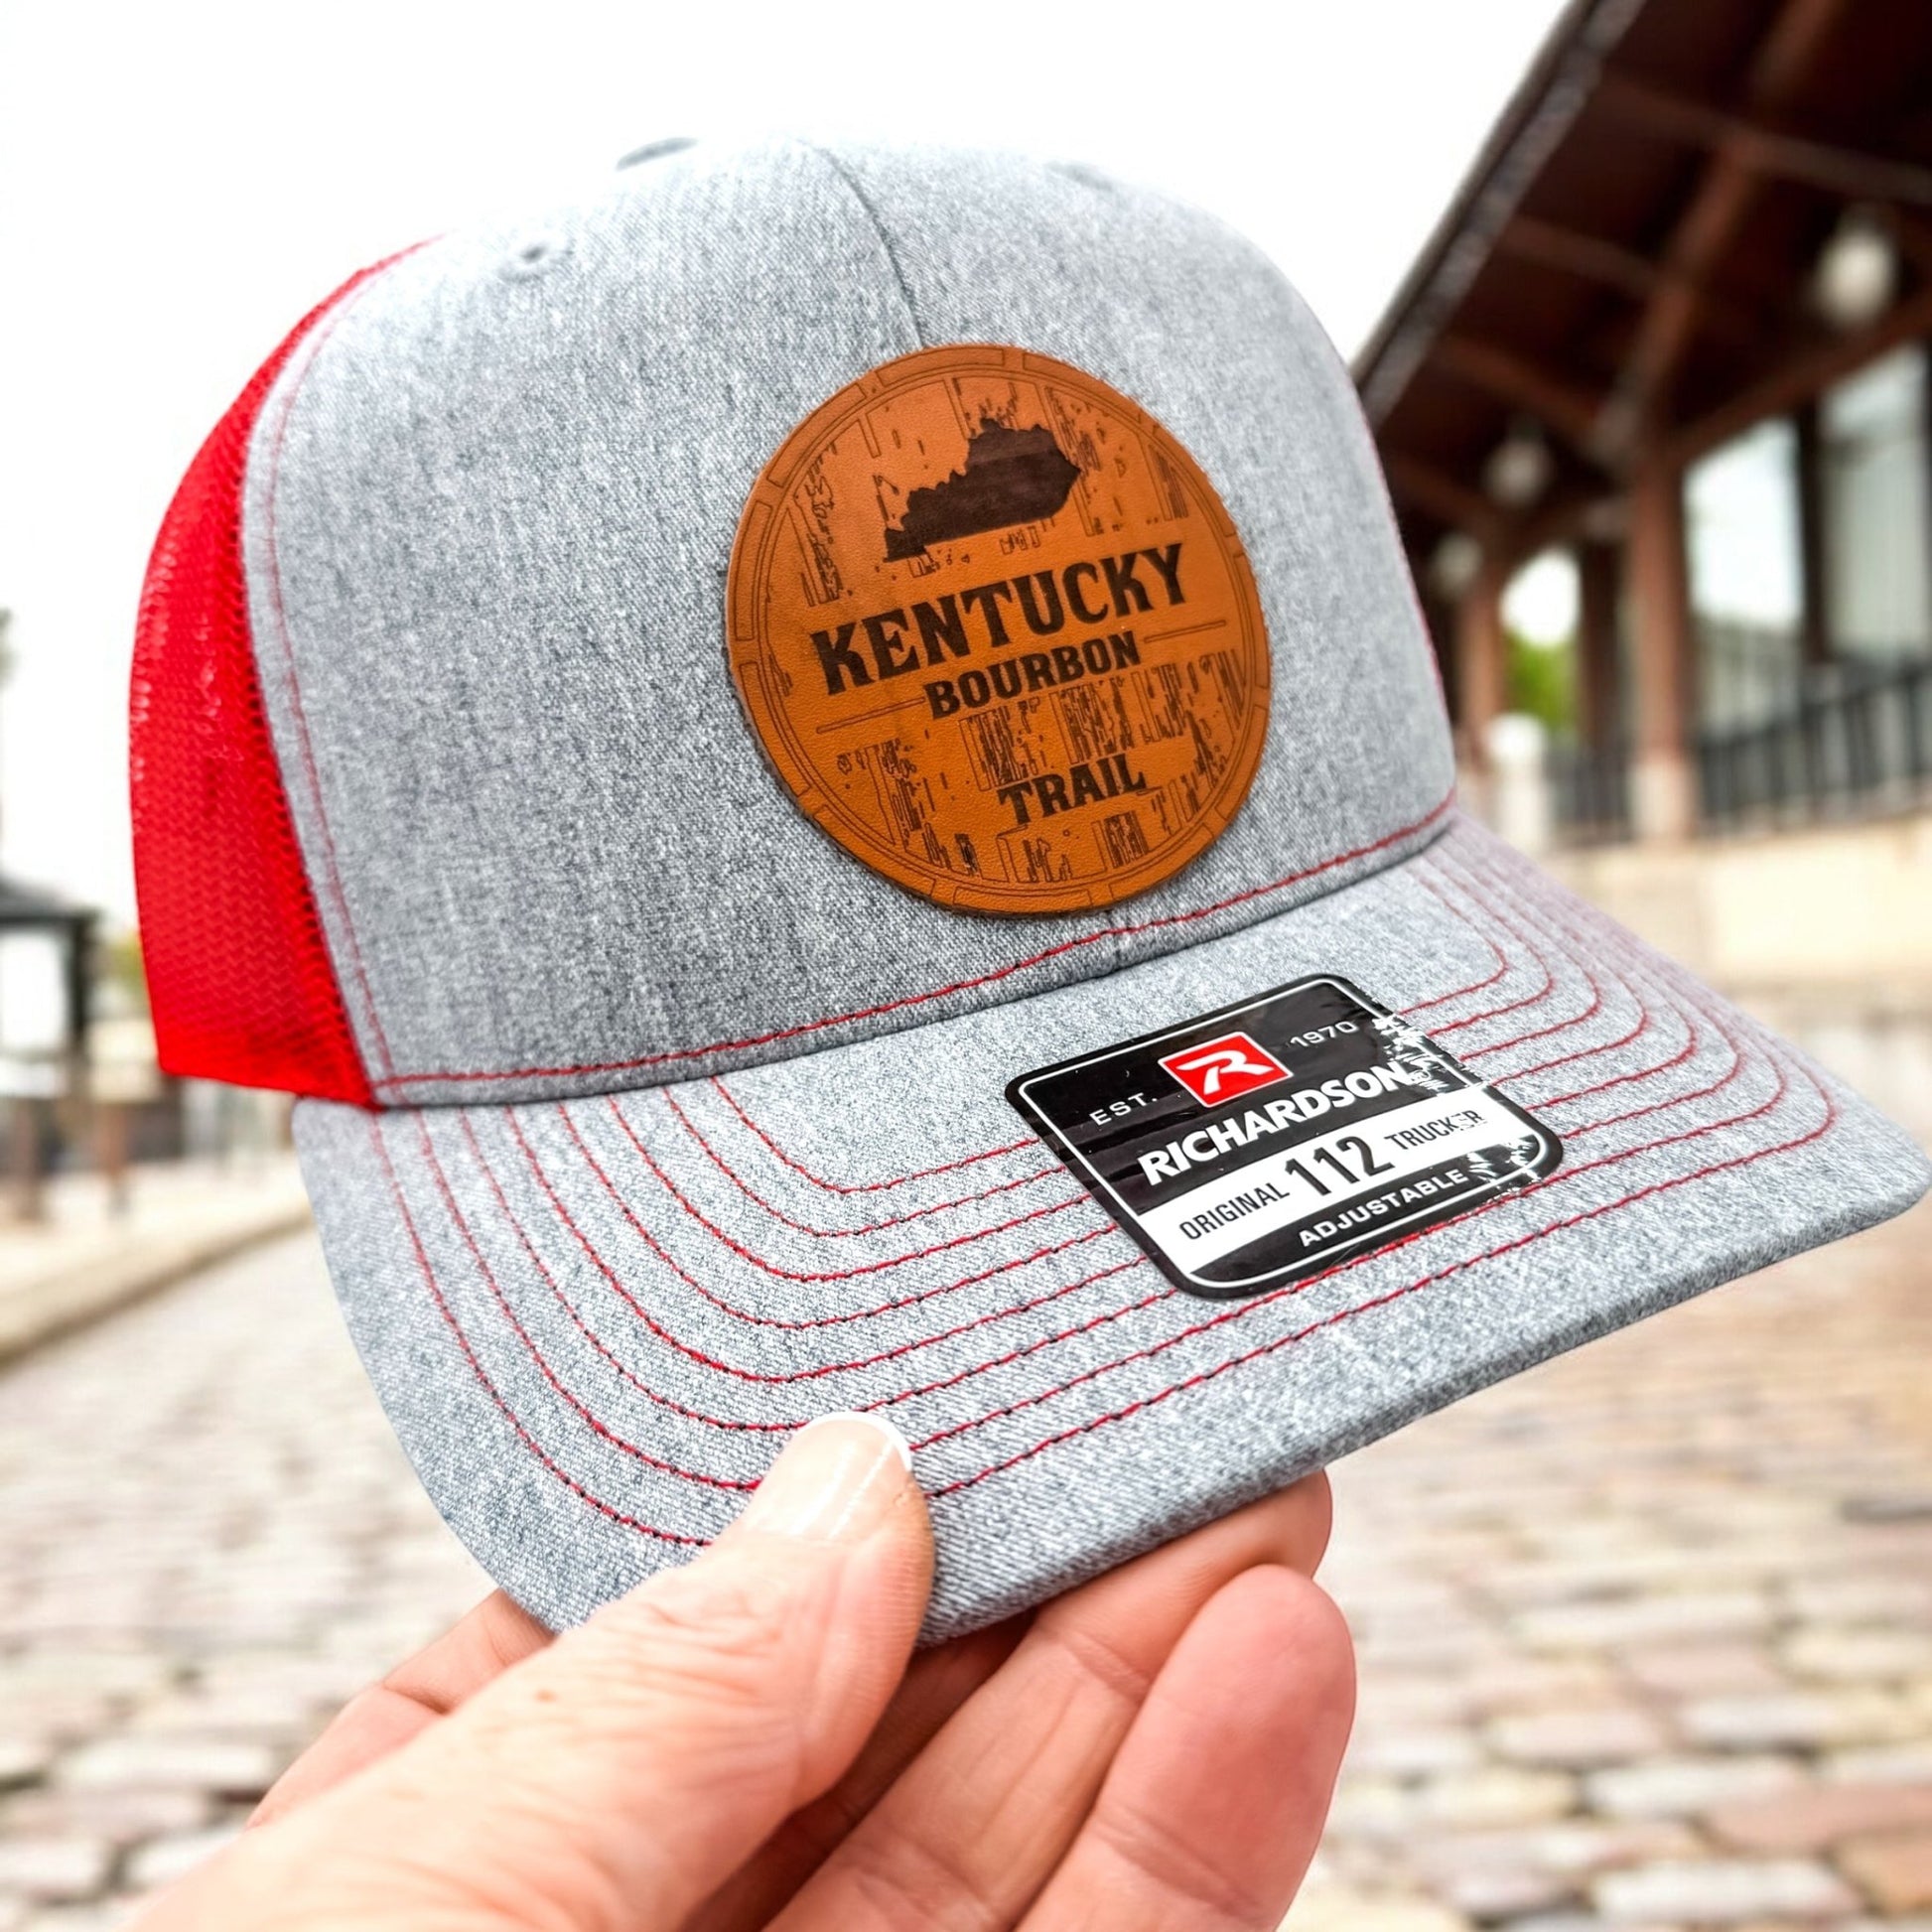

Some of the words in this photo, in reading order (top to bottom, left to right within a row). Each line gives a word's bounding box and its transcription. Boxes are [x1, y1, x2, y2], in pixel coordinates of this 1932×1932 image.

[810, 543, 1186, 695] KENTUCKY
[924, 631, 1141, 719] BOURBON
[997, 754, 1146, 825] TRAIL
[1089, 1092, 1158, 1126] EST.
[1290, 1021, 1357, 1048] 1970
[1139, 1061, 1415, 1186] RICHARDSON
[1179, 1182, 1291, 1240] ORIGINAL
[1286, 1136, 1394, 1196] 112
[1299, 1171, 1469, 1247] ADJUSTABLE
